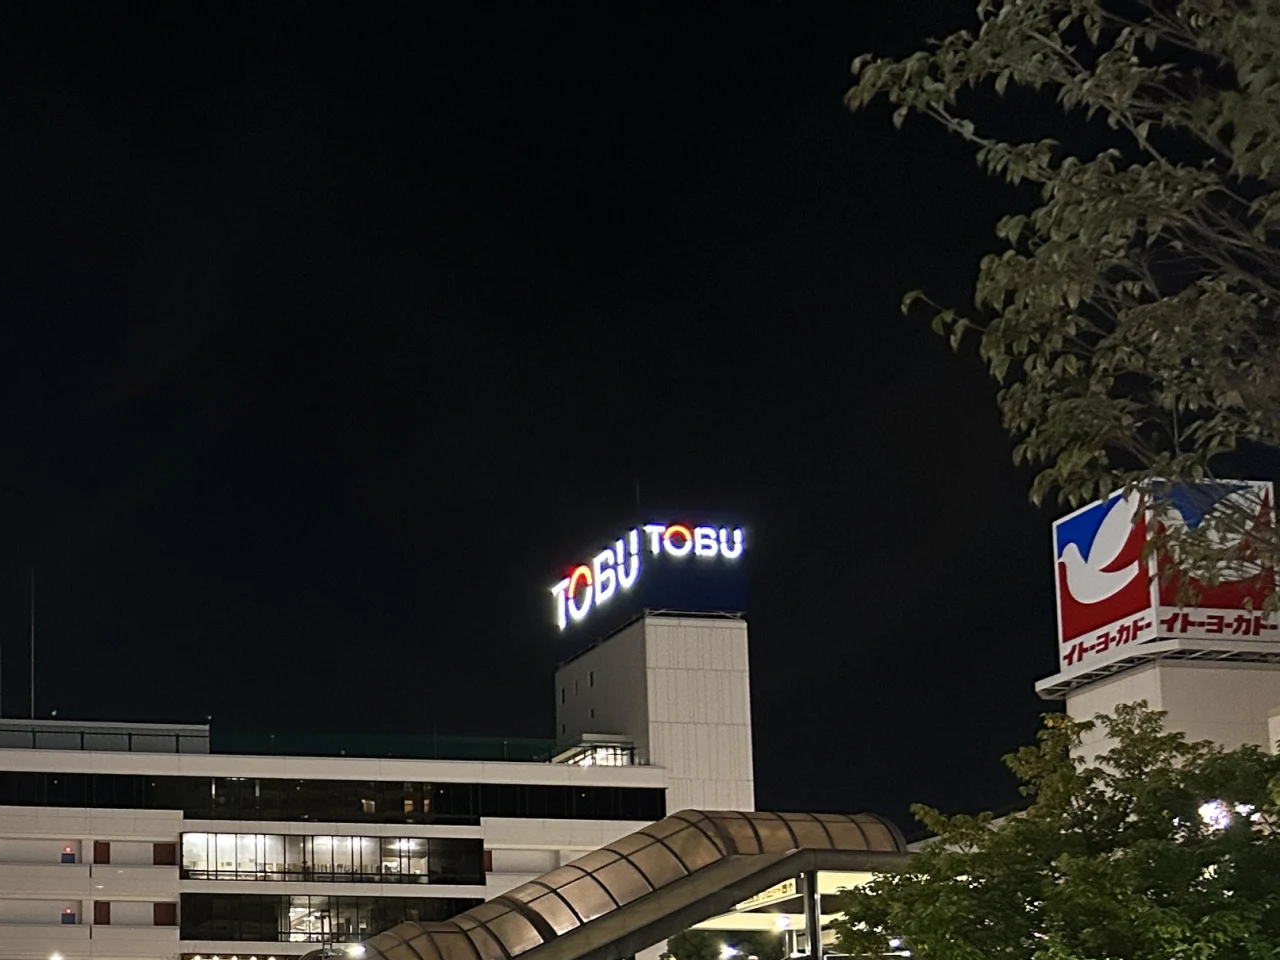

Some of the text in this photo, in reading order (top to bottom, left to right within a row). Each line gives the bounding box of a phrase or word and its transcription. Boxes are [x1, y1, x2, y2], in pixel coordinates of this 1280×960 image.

[644, 522, 744, 558] TOBU
[551, 527, 641, 631] TOBU
[1063, 617, 1152, 666] イトーヨーカドー
